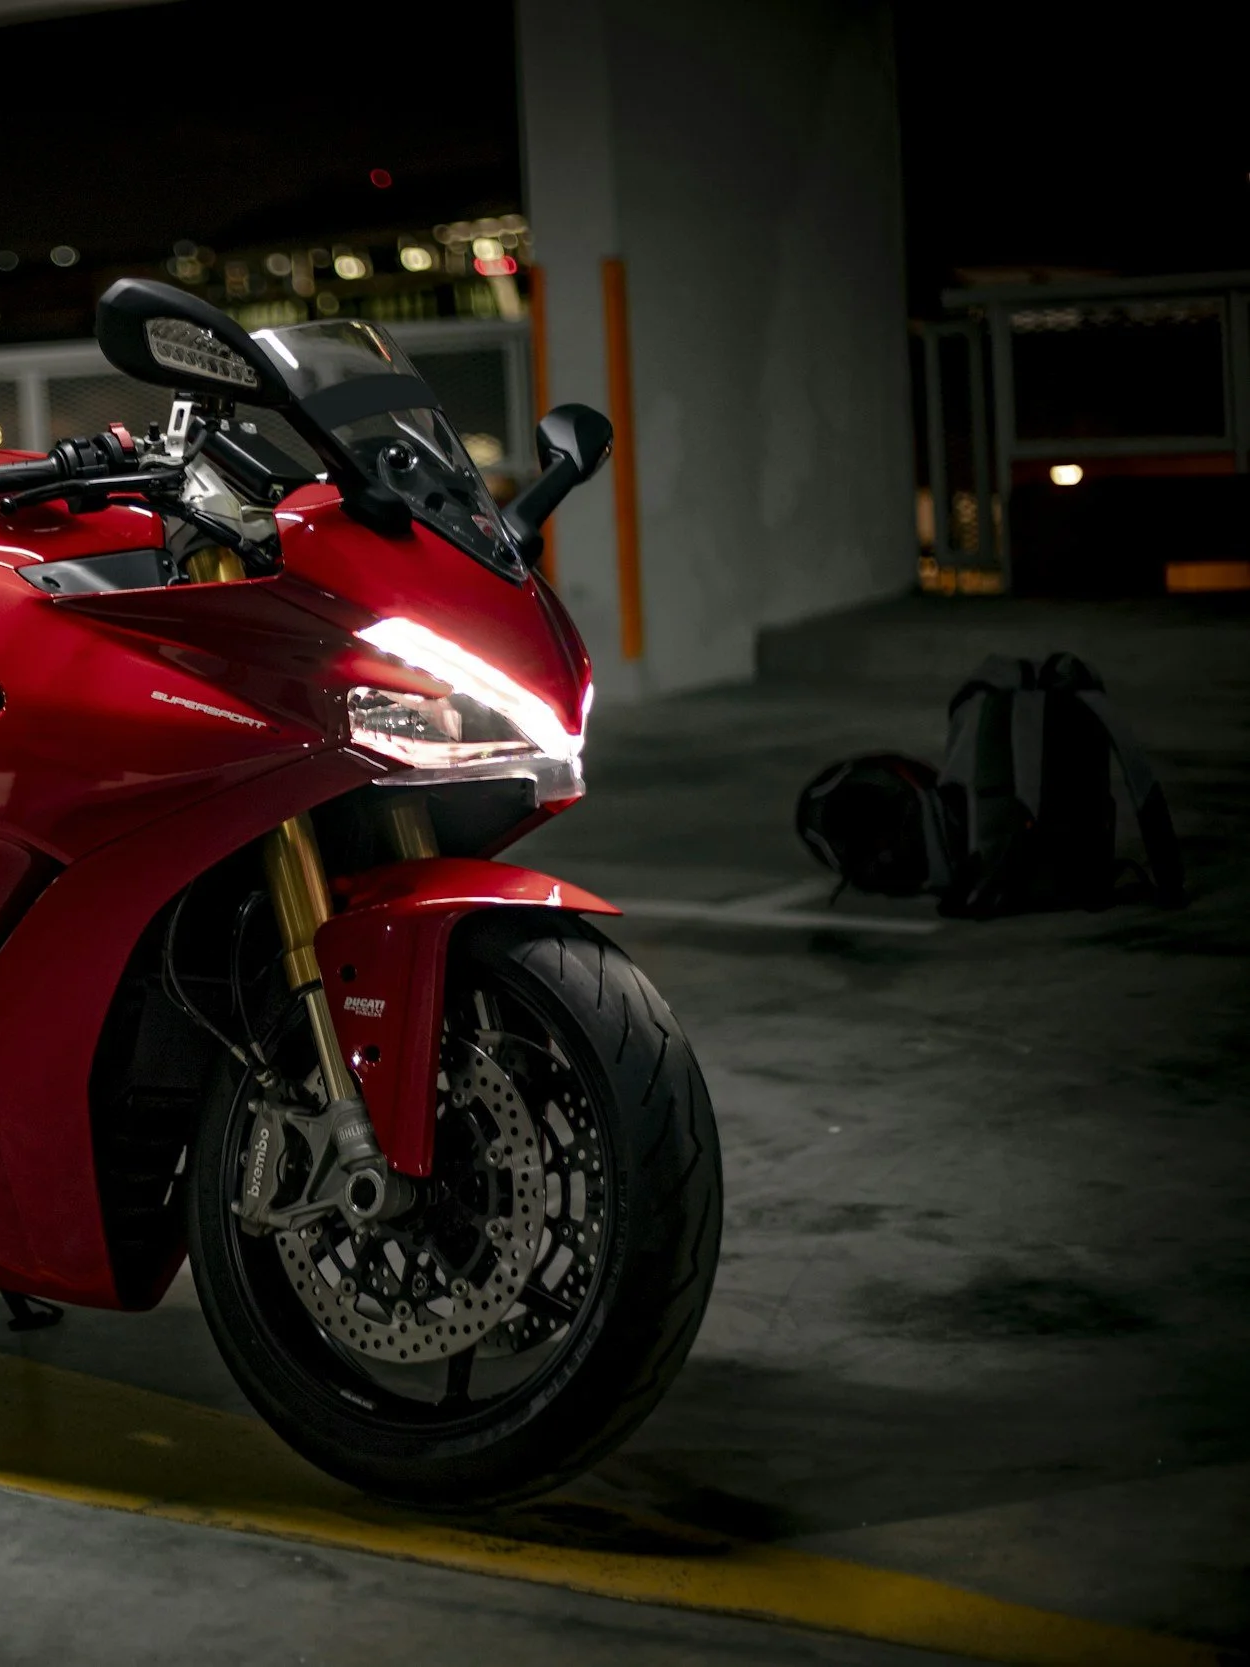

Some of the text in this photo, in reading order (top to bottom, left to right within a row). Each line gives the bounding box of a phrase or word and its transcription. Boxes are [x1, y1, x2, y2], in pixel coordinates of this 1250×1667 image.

[150, 690, 267, 729] SUPERSPORT
[344, 996, 386, 1009] DUCATI
[246, 1128, 270, 1198] brembo
